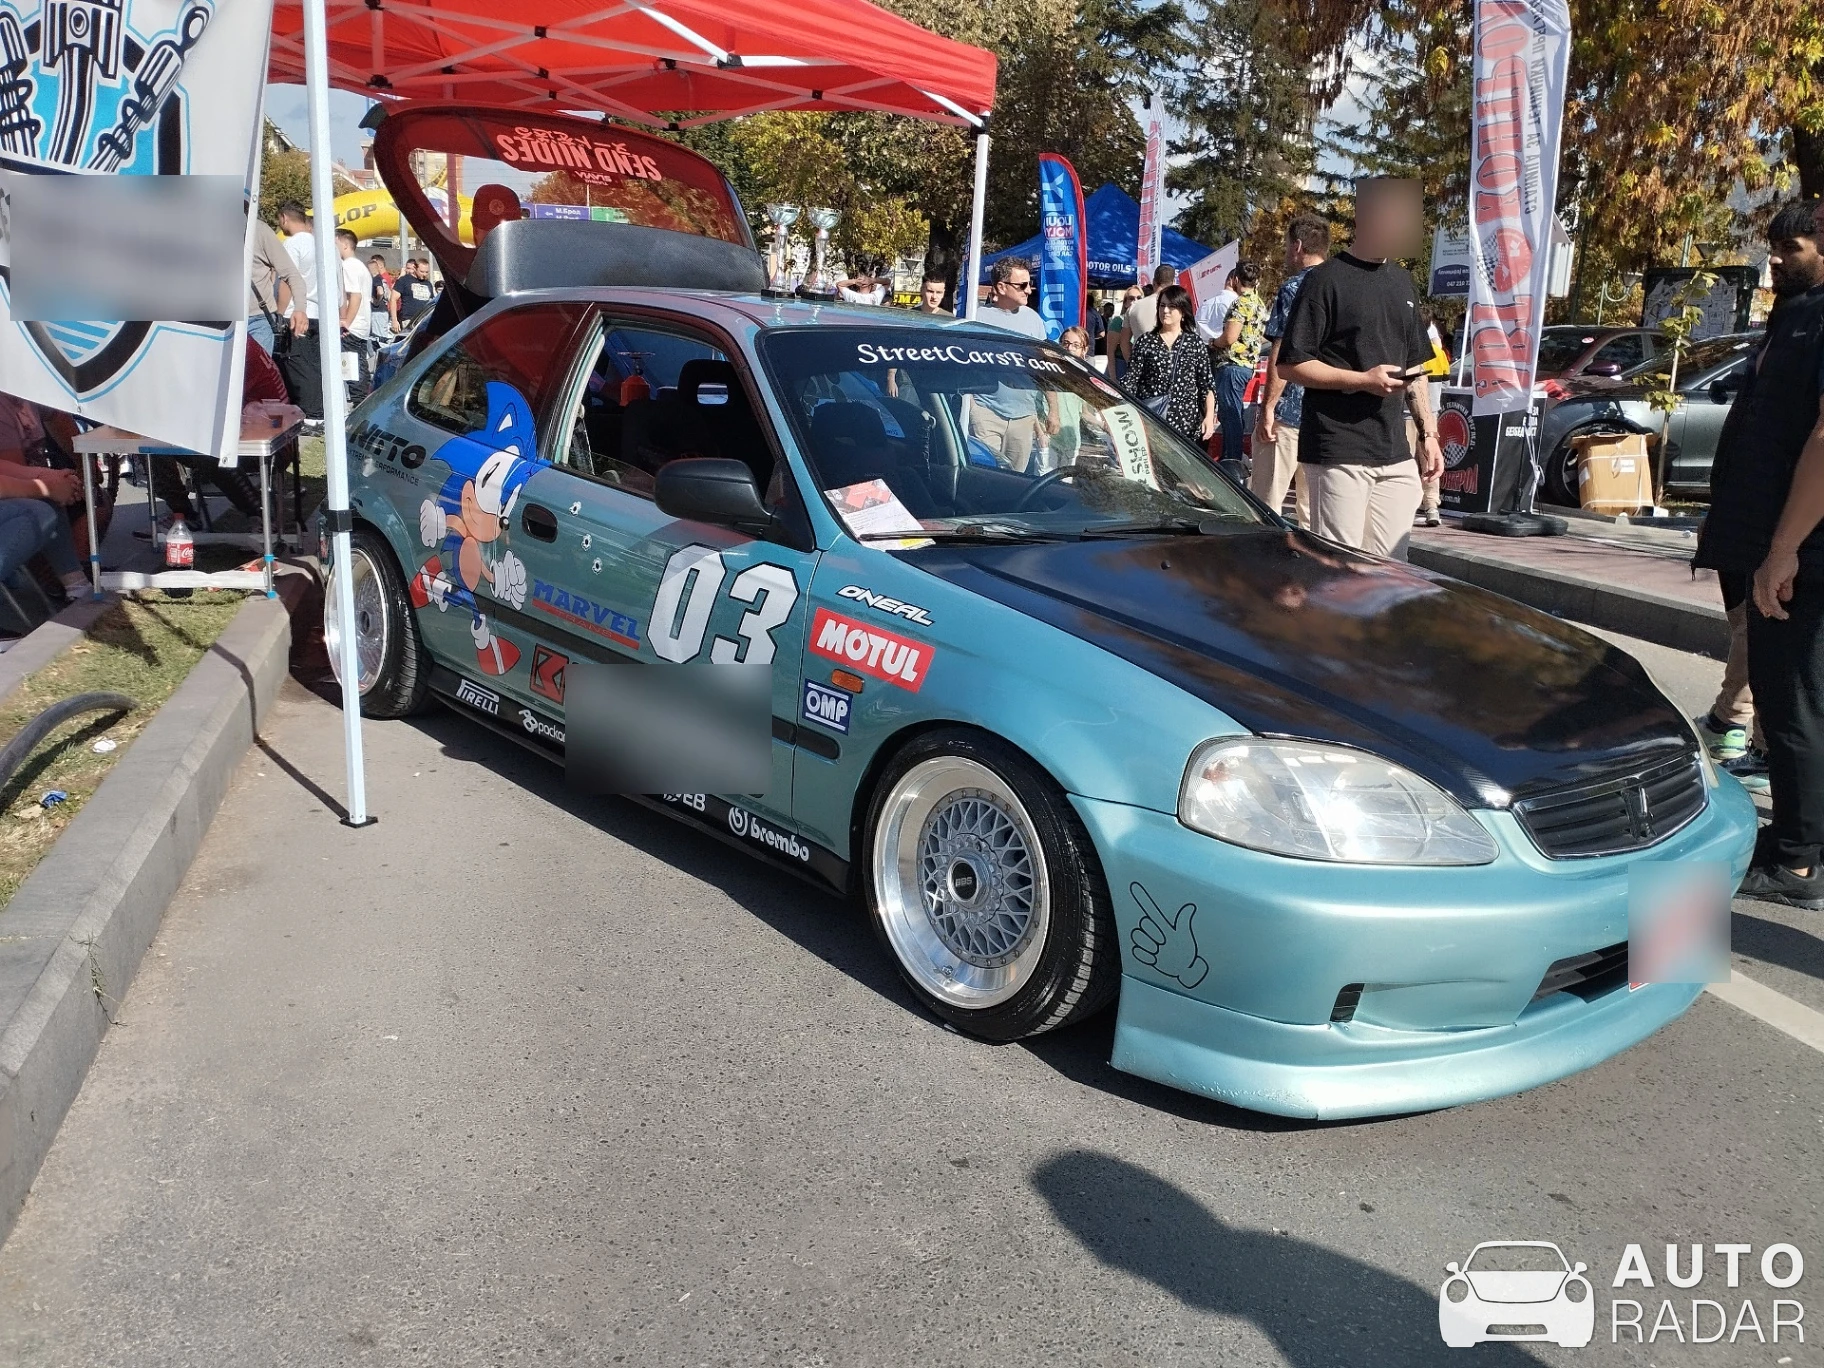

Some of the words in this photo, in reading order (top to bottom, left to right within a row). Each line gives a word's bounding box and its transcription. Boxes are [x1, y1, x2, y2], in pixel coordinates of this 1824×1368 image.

[496, 134, 592, 169] NUDES
[594, 147, 662, 182] SEND
[334, 203, 377, 228] LOP
[373, 460, 420, 487] ERFORMANCE
[533, 579, 641, 641] MARVEL
[647, 542, 800, 664] 03
[816, 618, 921, 682] MOTUL
[456, 679, 500, 715] PIRELLI
[806, 690, 849, 722] OMP
[750, 817, 810, 862] brembo
[955, 876, 973, 887] BBS
